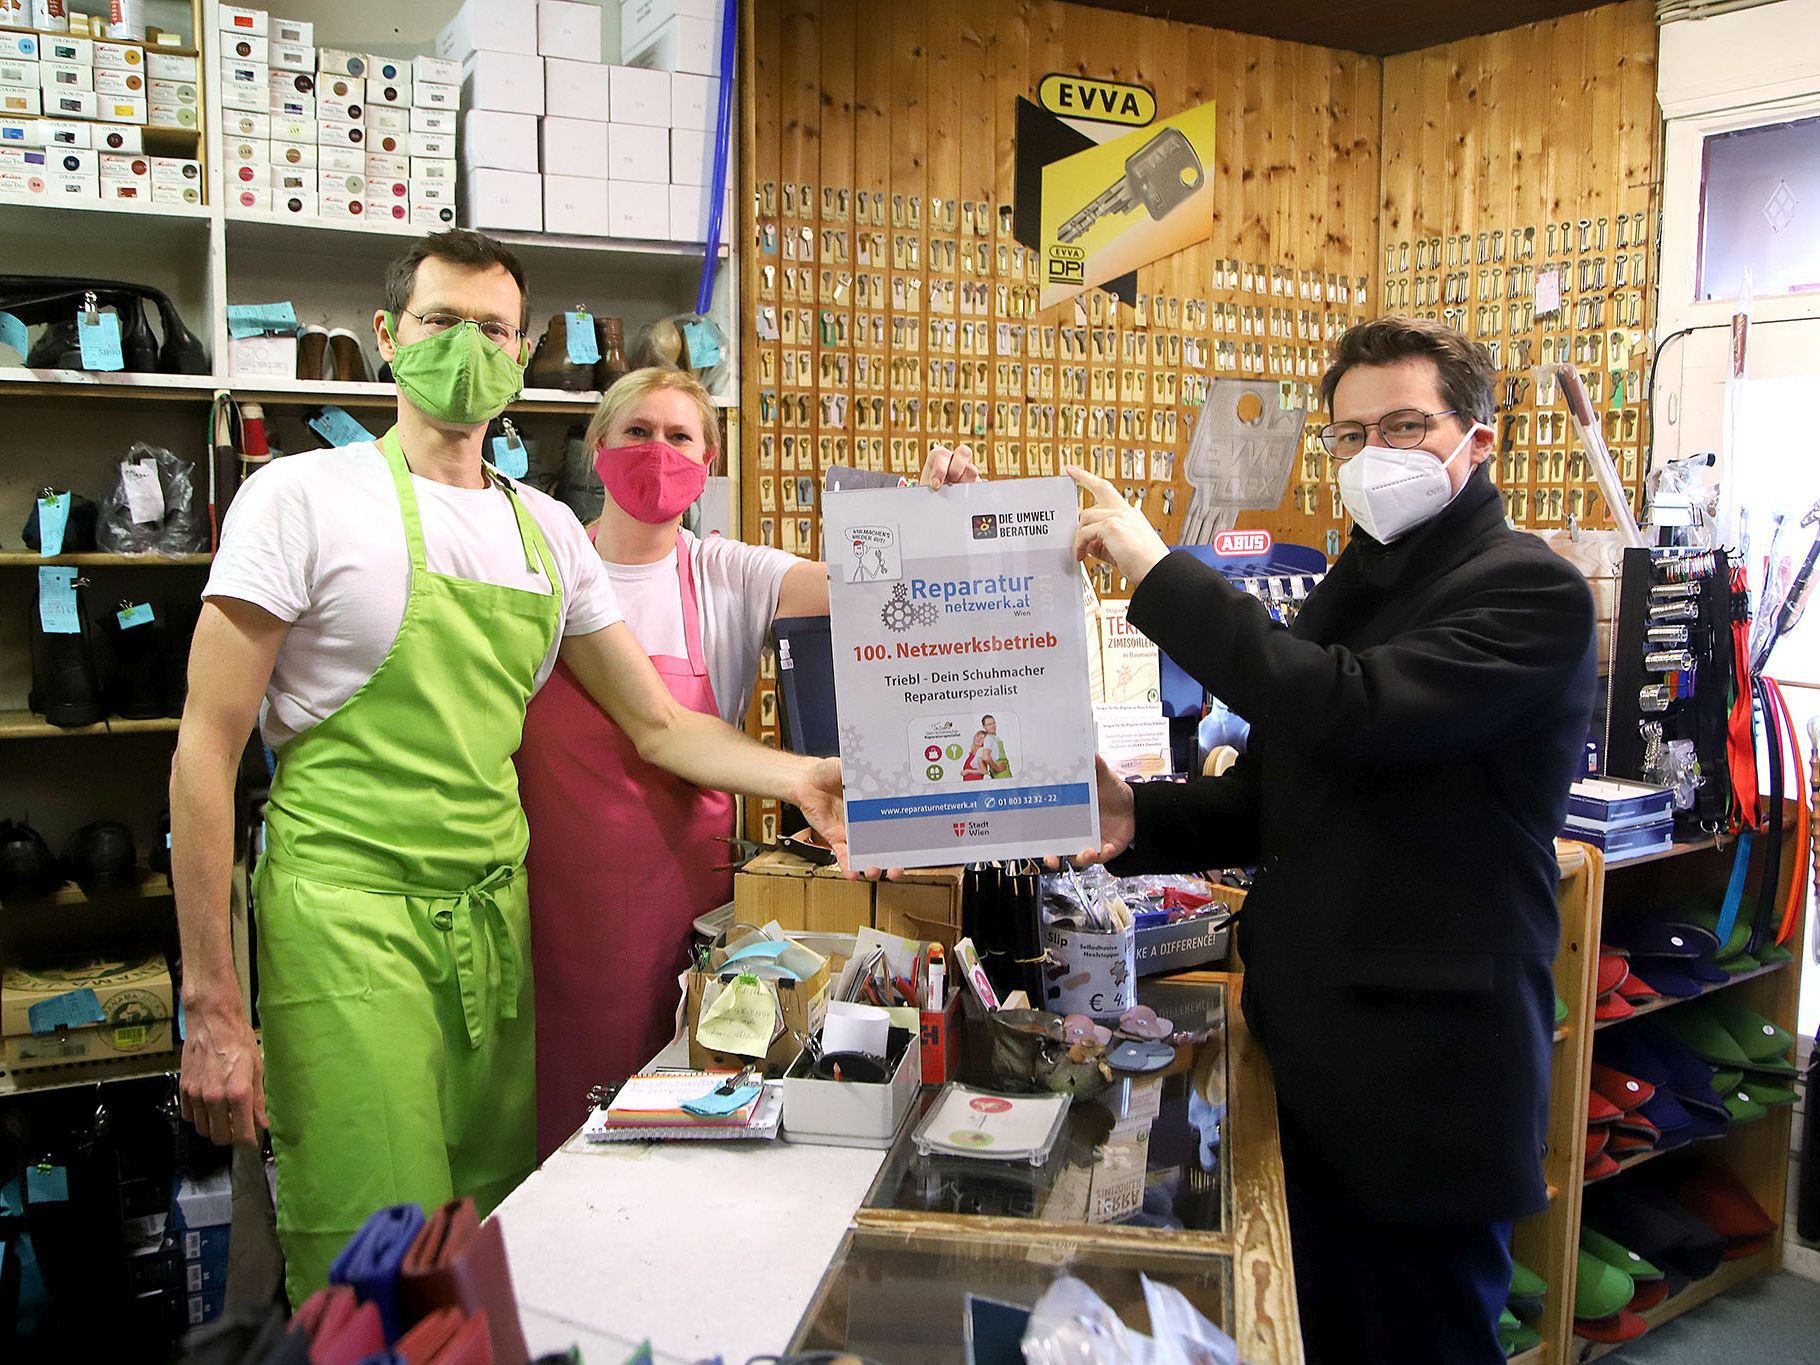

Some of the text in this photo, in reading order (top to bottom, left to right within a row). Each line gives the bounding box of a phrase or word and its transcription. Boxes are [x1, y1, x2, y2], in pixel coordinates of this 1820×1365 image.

[1060, 83, 1140, 117] EVVA
[1056, 248, 1079, 257] EVVA
[1049, 259, 1084, 277] DPI
[999, 511, 1055, 524] DIE UMWELT
[1000, 525, 1048, 538] BERATUNG
[1221, 535, 1264, 551] ABUS
[911, 575, 1034, 601] Reparatur
[945, 594, 1030, 613] netzwerk.at
[854, 632, 1058, 662] 100. Netzwerksbetrieb
[884, 673, 920, 687] Triebl
[931, 669, 959, 684] Dein
[962, 665, 1046, 682] Schuhmacher
[904, 684, 1018, 704] Reparaturspezialist
[880, 801, 977, 816] www.reparaturnetzwerk.at
[998, 798, 1007, 806] 01
[1008, 796, 1022, 806] 803
[1023, 795, 1032, 804] 32
[1033, 795, 1043, 804] 32
[1048, 794, 1057, 802] 22
[968, 821, 989, 829] Stadt
[968, 829, 990, 837] Wien
[1150, 945, 1157, 957] A
[1160, 934, 1216, 956] DIFFERENCE!
[1089, 994, 1104, 1012] €
